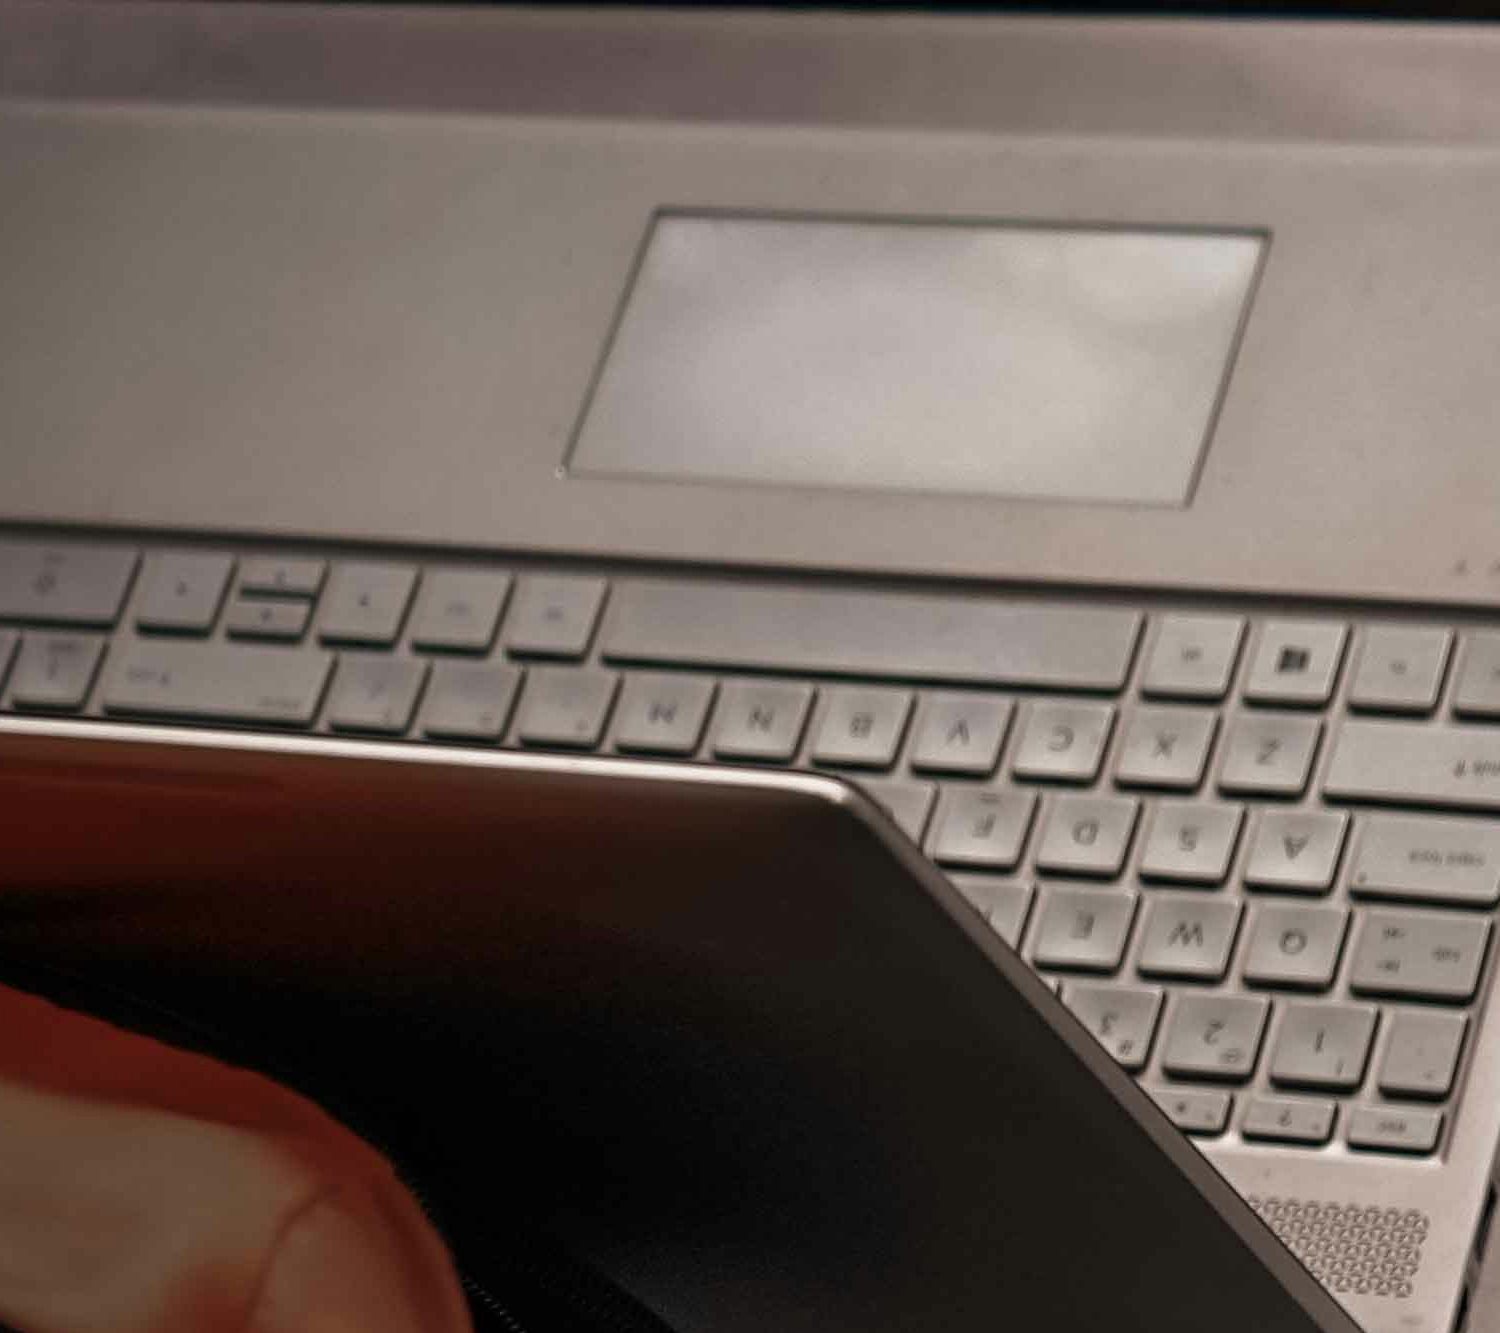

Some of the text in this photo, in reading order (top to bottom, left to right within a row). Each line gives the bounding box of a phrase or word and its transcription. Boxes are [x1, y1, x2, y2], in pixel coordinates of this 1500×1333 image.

[1051, 726, 1073, 752] C
[1073, 820, 1097, 846] D
[1282, 831, 1310, 860] A
[1167, 920, 1203, 949] W
[1279, 929, 1307, 955] Q
[1203, 1022, 1223, 1045] 2
